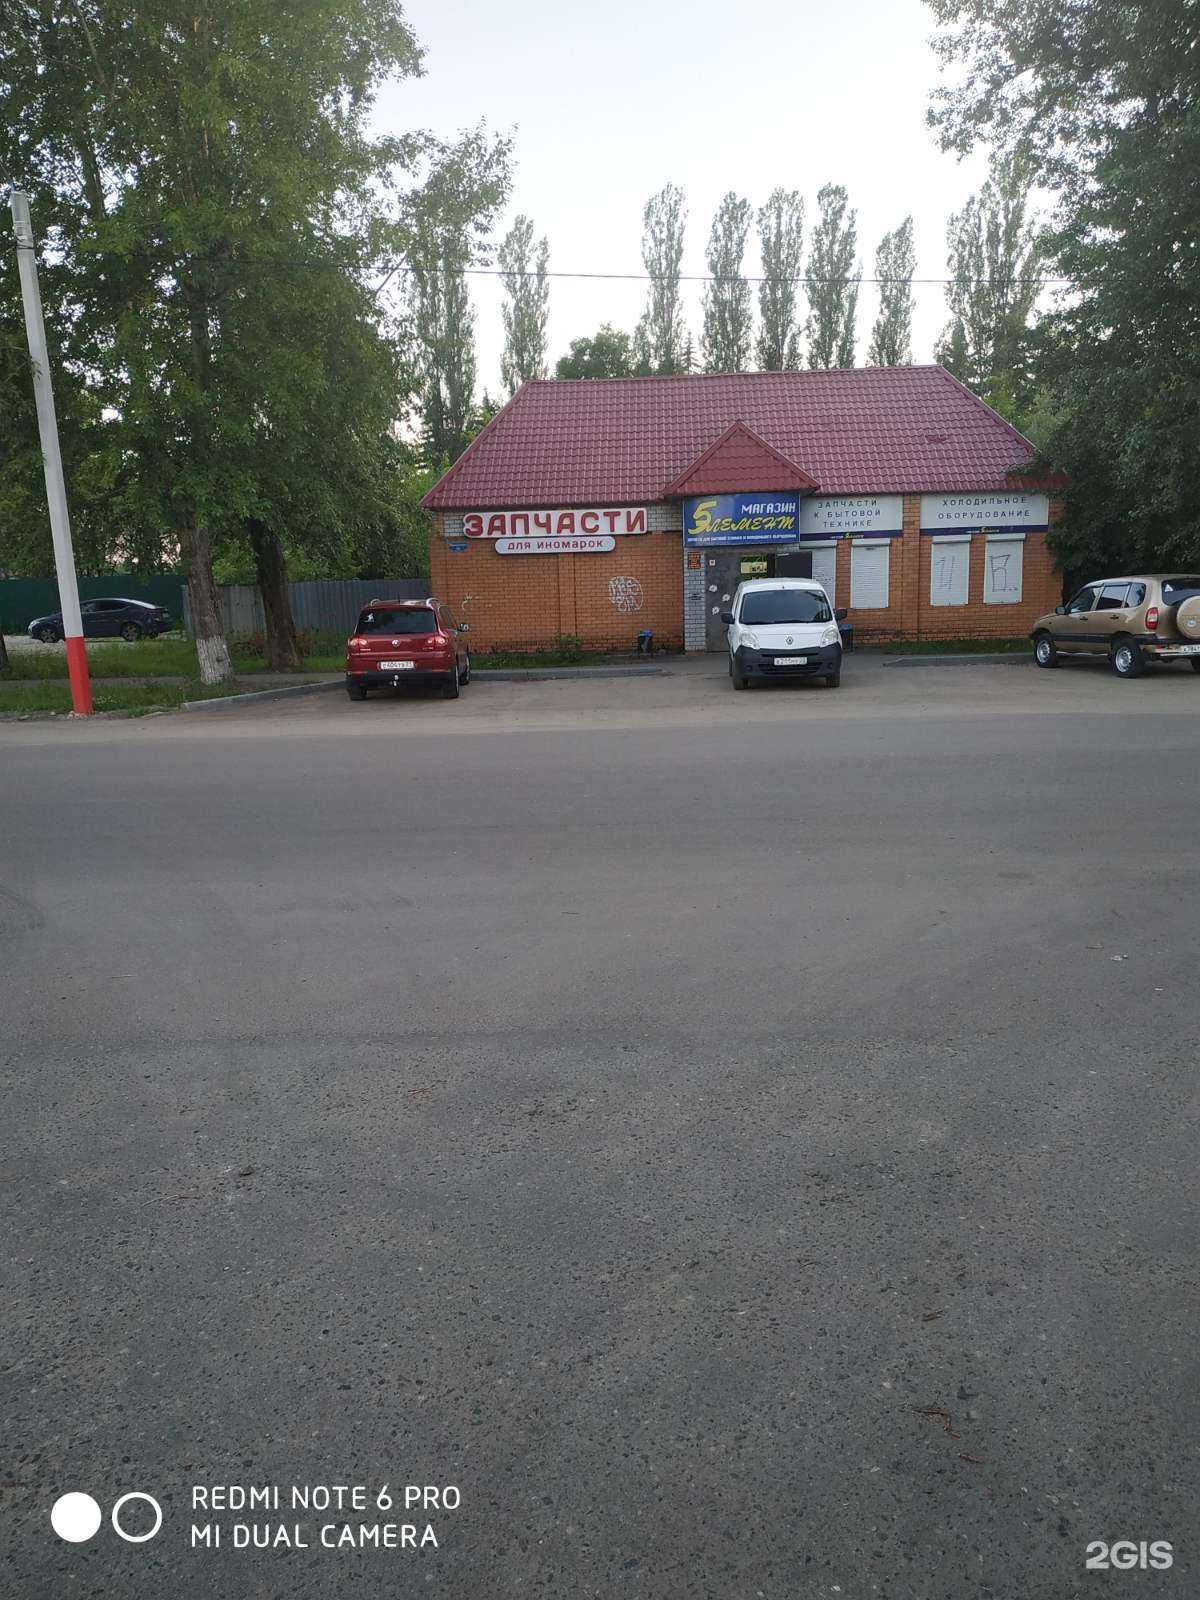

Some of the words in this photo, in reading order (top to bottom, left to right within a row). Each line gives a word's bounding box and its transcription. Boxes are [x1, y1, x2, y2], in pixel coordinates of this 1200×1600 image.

[817, 499, 878, 509] ЗАПЧАСТИ
[942, 496, 1028, 506] ХОЛОДИЛЬНОЕ
[741, 502, 796, 514] МАГАЗИН
[826, 508, 881, 518] БЫТОВОЙ
[937, 509, 1032, 520] ОБОРУДОВАНИЕ
[465, 511, 645, 536] ЗАПЧАСТИ
[823, 519, 873, 528] ТЕХНИКЕ
